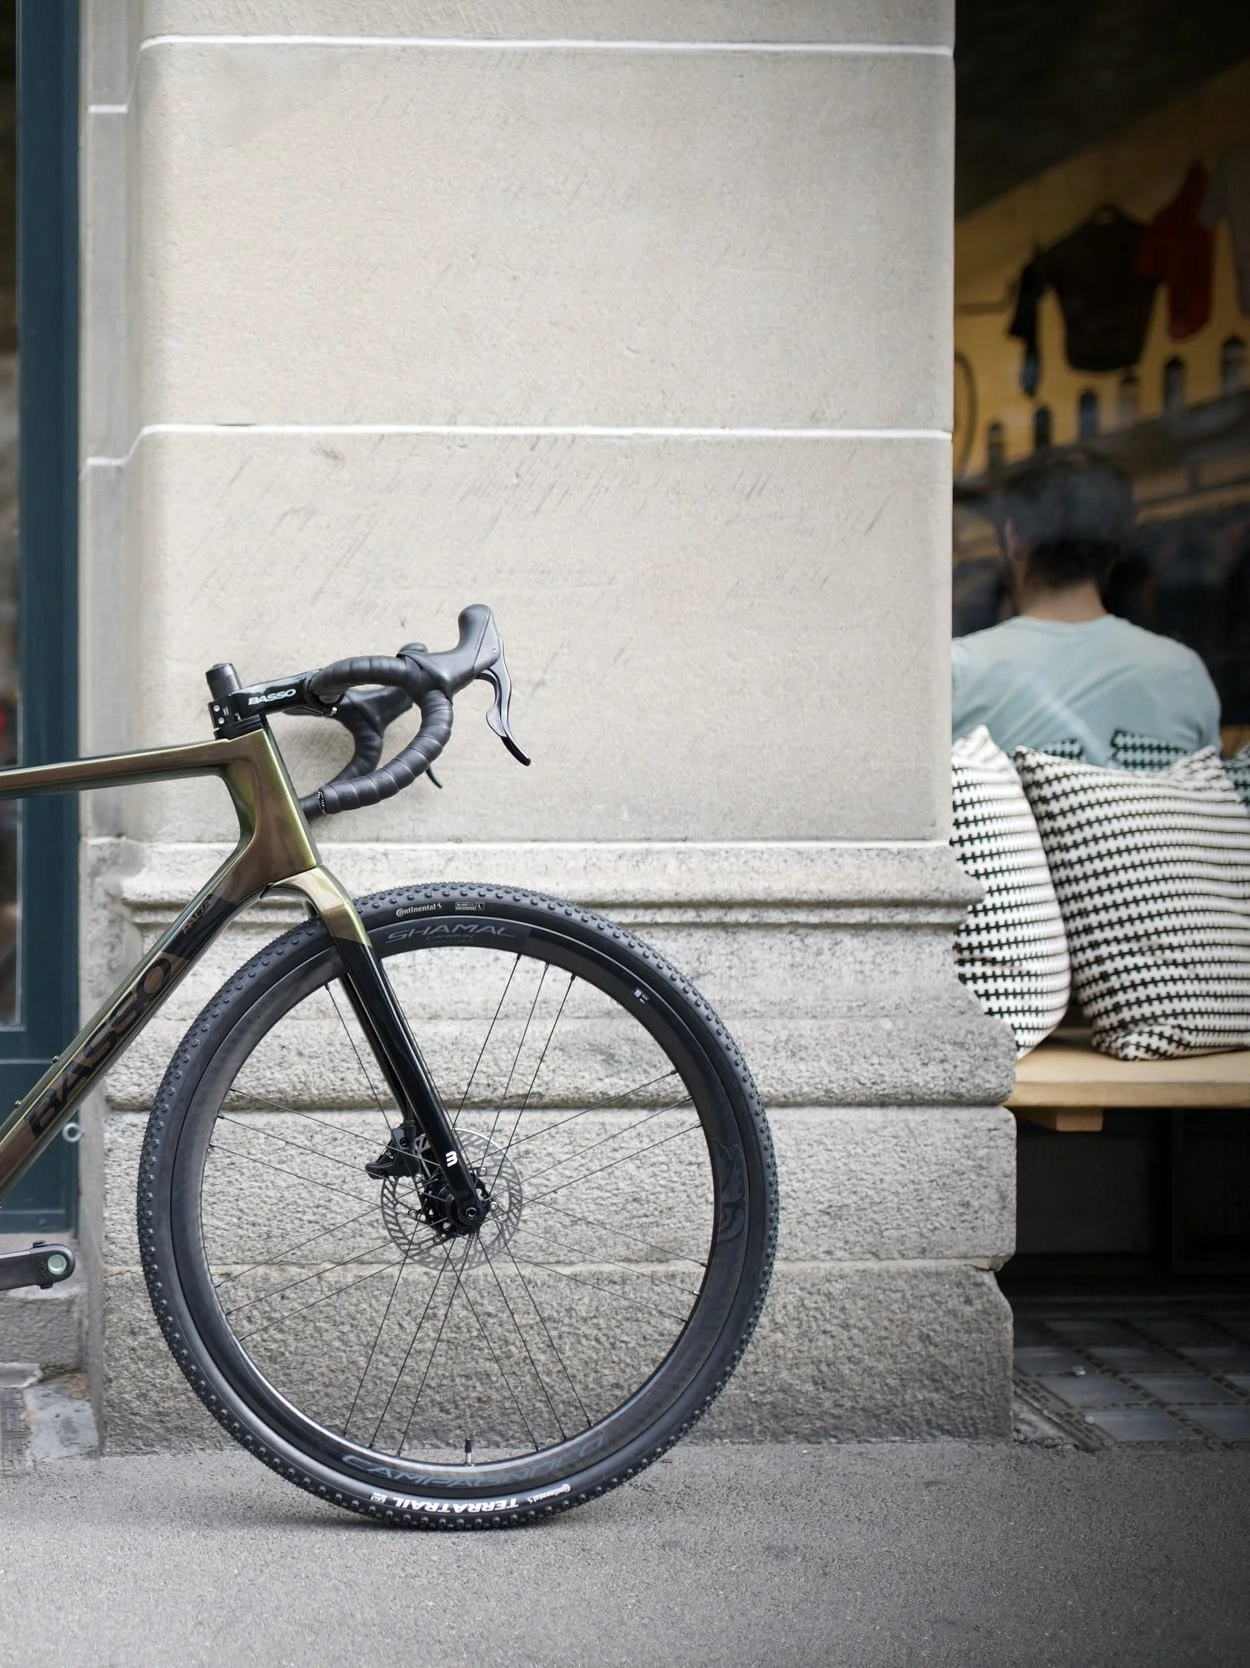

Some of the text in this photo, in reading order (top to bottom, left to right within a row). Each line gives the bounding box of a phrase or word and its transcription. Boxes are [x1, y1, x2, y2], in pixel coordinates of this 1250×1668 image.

[248, 688, 297, 706] BASSO
[395, 903, 437, 917] Continental
[385, 923, 516, 944] SHAMAL
[25, 957, 172, 1140] BASSO
[393, 1496, 451, 1513] TRAIL
[453, 1496, 519, 1514] TERRA
